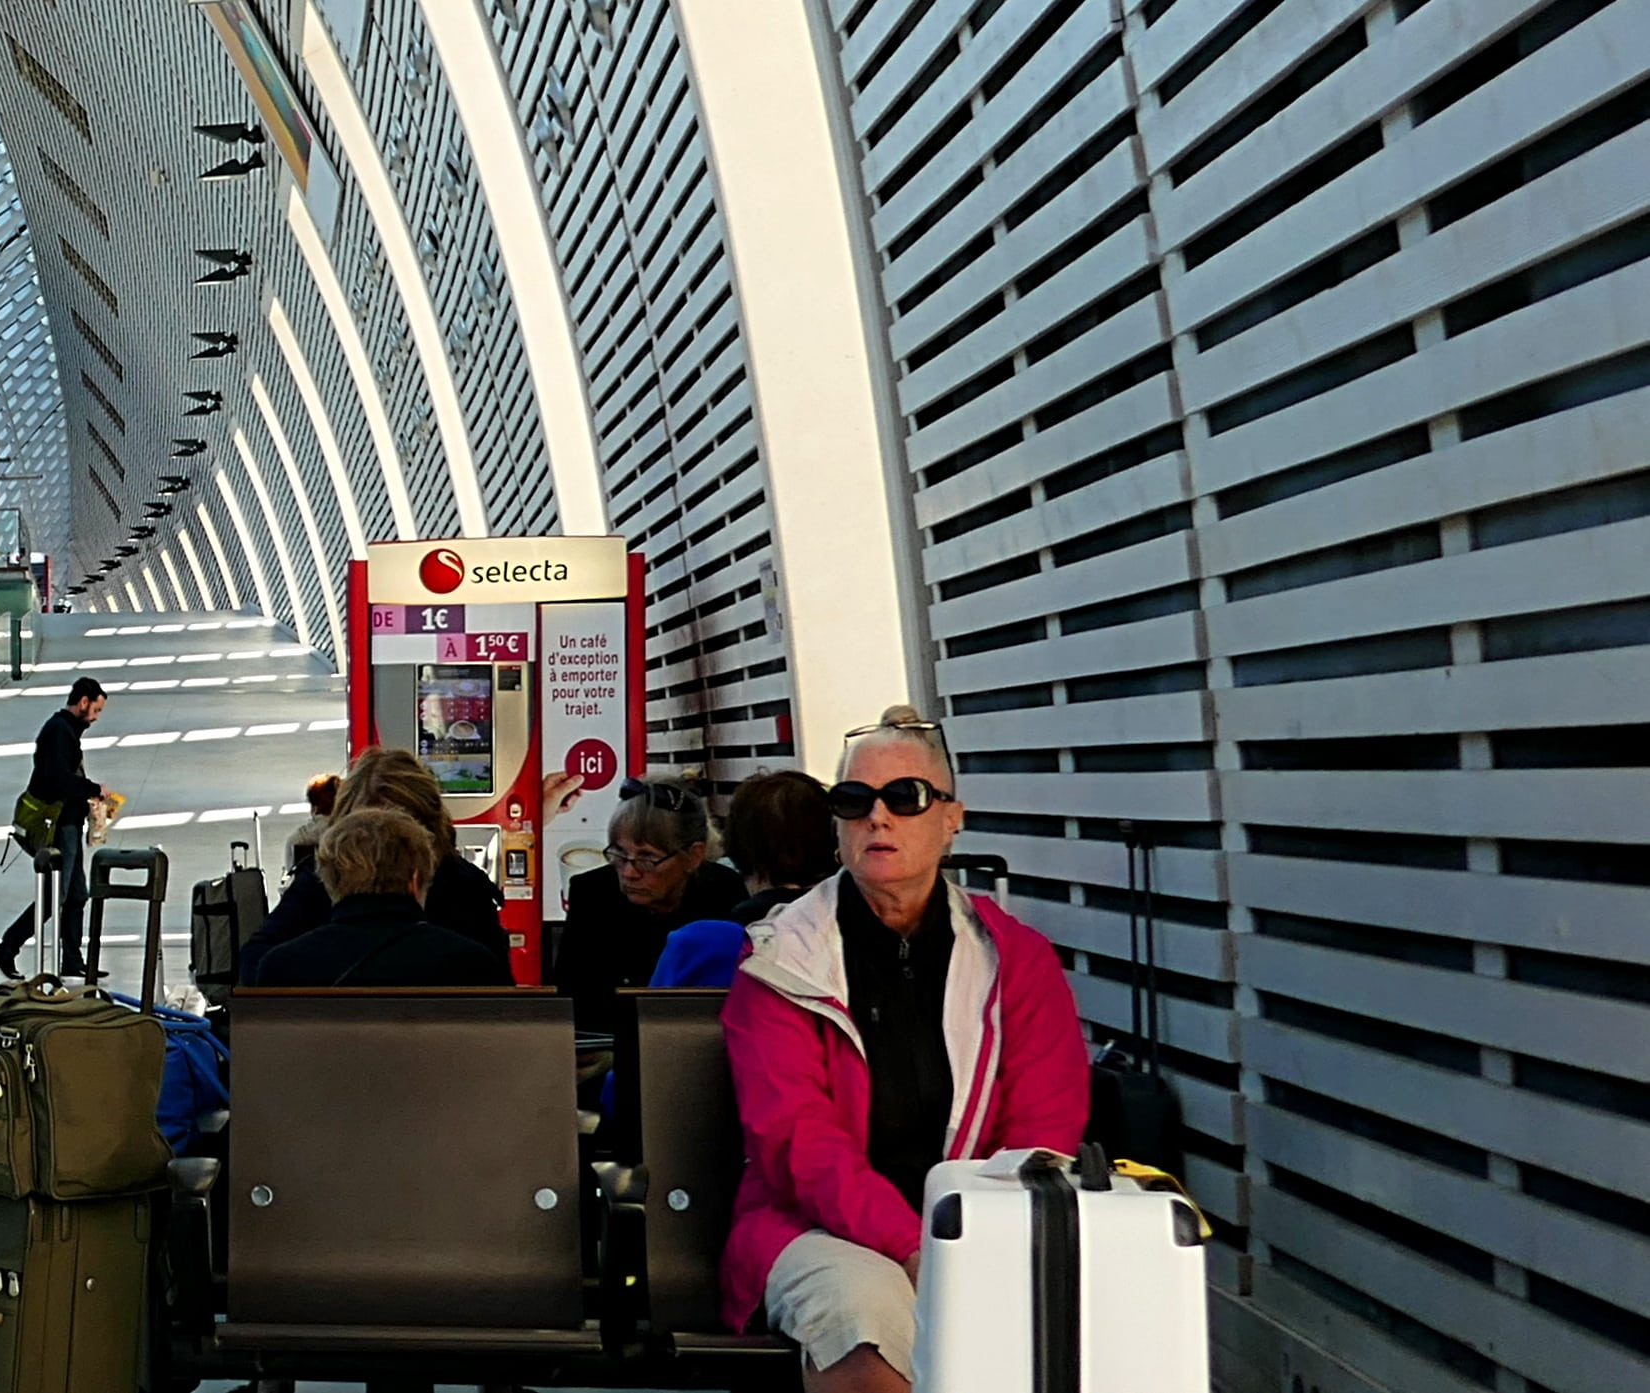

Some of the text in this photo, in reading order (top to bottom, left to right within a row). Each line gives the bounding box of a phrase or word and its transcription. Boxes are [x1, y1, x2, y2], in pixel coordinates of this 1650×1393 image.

[471, 560, 568, 584] selecta
[373, 608, 448, 630] DE 1€
[445, 638, 457, 658] À
[559, 633, 607, 649] Un café
[548, 651, 619, 668] d'exception
[549, 669, 618, 684] à emporter
[552, 685, 615, 702] pour votre
[565, 702, 602, 719] trajet.
[580, 751, 602, 774] ici
